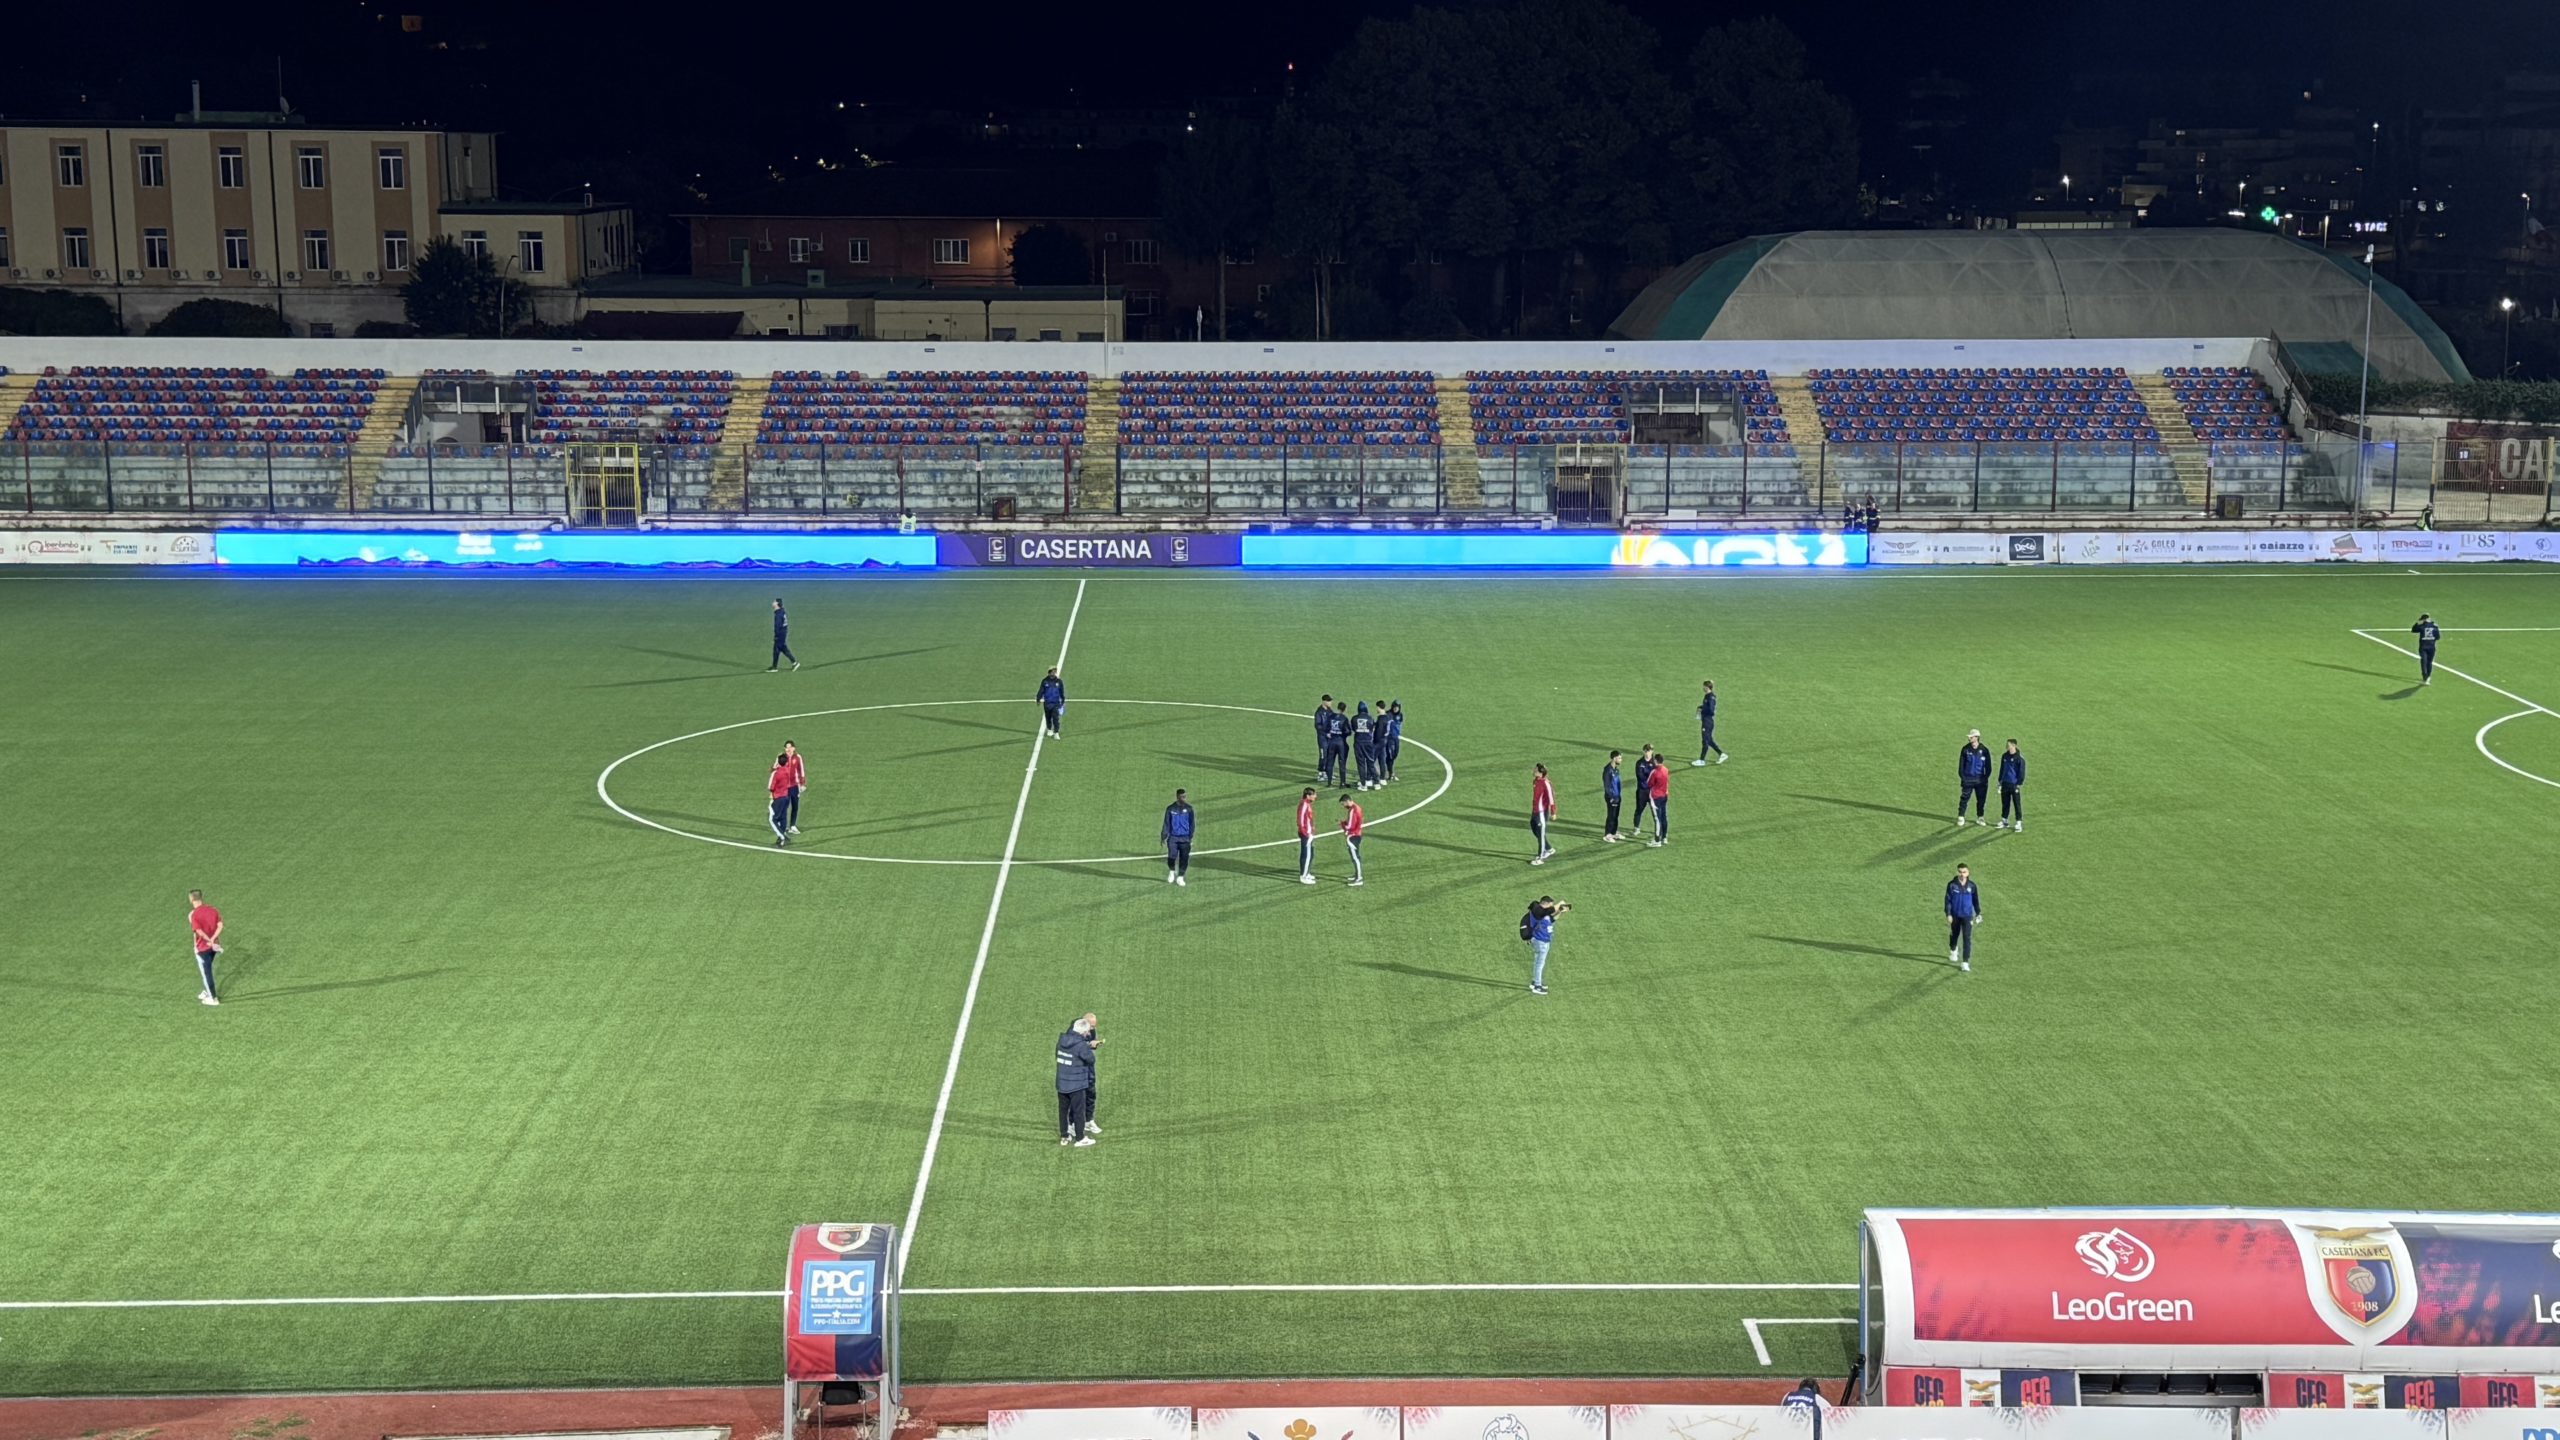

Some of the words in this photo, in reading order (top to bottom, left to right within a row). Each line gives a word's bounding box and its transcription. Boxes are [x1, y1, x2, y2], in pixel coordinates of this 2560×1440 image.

[1020, 539, 1152, 559] CASERTANA
[2260, 542, 2304, 550] caiazzo
[2321, 1247, 2373, 1257] CASERTANA
[811, 1269, 865, 1297] PPG
[2052, 1291, 2193, 1321] LeoGreen
[2351, 1301, 2379, 1312] 1908
[1914, 1374, 1944, 1406] CFC
[2020, 1376, 2052, 1406] CFC
[2296, 1377, 2327, 1408] CFC
[2404, 1379, 2435, 1409] CFC
[2487, 1380, 2518, 1407] CFC
